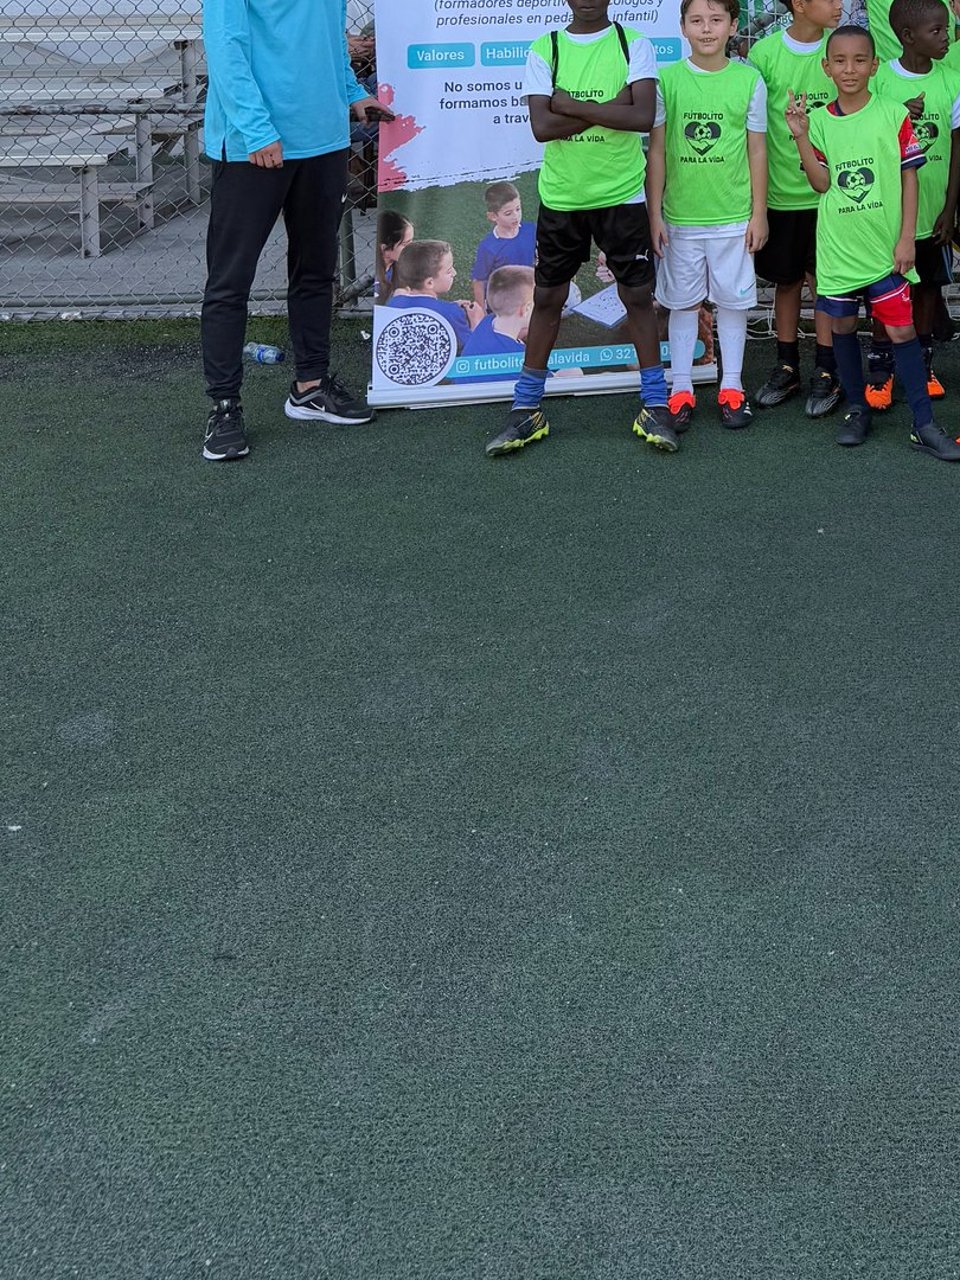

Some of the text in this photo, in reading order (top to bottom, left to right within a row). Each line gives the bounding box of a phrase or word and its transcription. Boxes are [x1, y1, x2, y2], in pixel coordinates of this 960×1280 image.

[436, 13, 523, 28] profesionales
[526, 14, 541, 24] en
[612, 10, 659, 23] infantil)
[417, 49, 465, 61] Valores
[444, 82, 463, 93] No
[467, 81, 511, 91] somos
[440, 98, 508, 110] formamos
[493, 115, 501, 124] a
[838, 206, 855, 214] PARA
